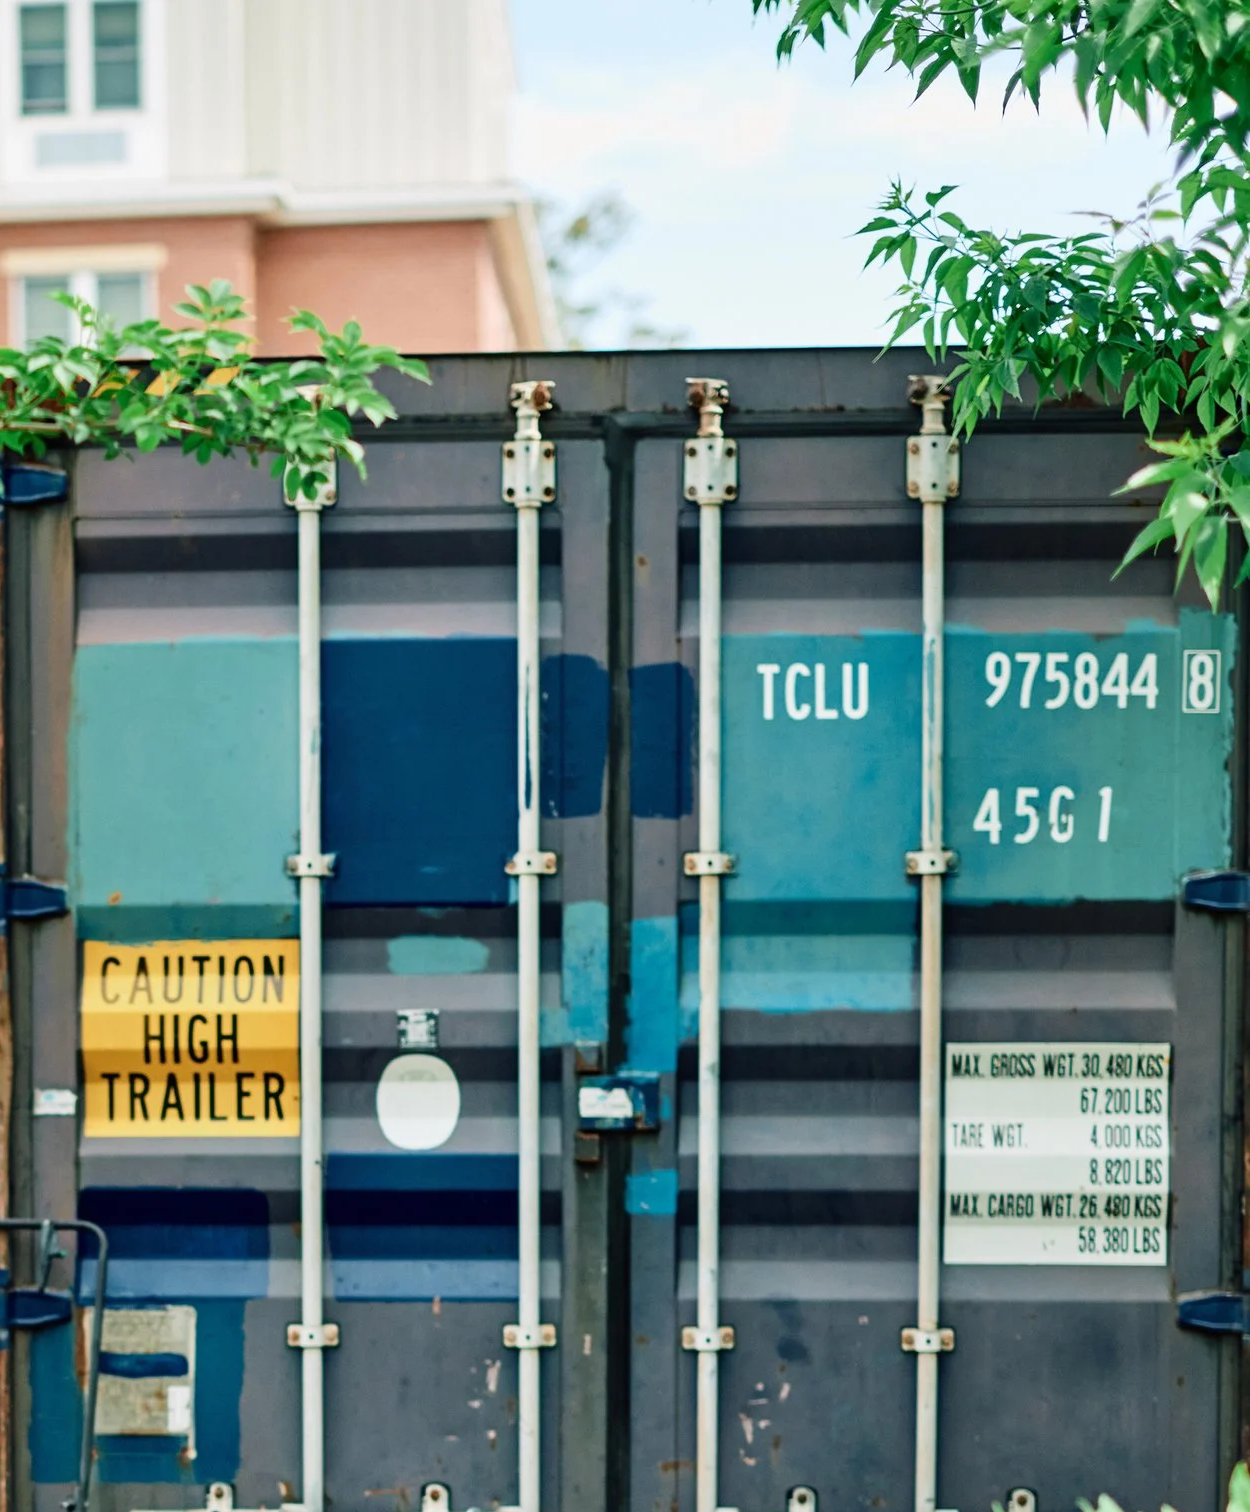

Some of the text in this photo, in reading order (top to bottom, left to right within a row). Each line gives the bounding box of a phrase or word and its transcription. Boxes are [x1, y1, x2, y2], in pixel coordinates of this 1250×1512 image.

[757, 651, 1215, 721] TCLU 975844 8
[101, 955, 285, 1004] CAUTION
[144, 1014, 240, 1064] HIGH
[990, 1053, 1036, 1078] GROSS
[1136, 1053, 1164, 1078] KGS
[100, 1072, 285, 1121] TRAILER
[1135, 1087, 1162, 1115] LBS
[952, 1123, 984, 1148] TARE
[1136, 1124, 1162, 1149] KGS
[1135, 1158, 1162, 1185] LBS
[988, 1193, 1034, 1218] CARGO
[1134, 1193, 1162, 1219] KGS
[1133, 1226, 1160, 1254] LBS
